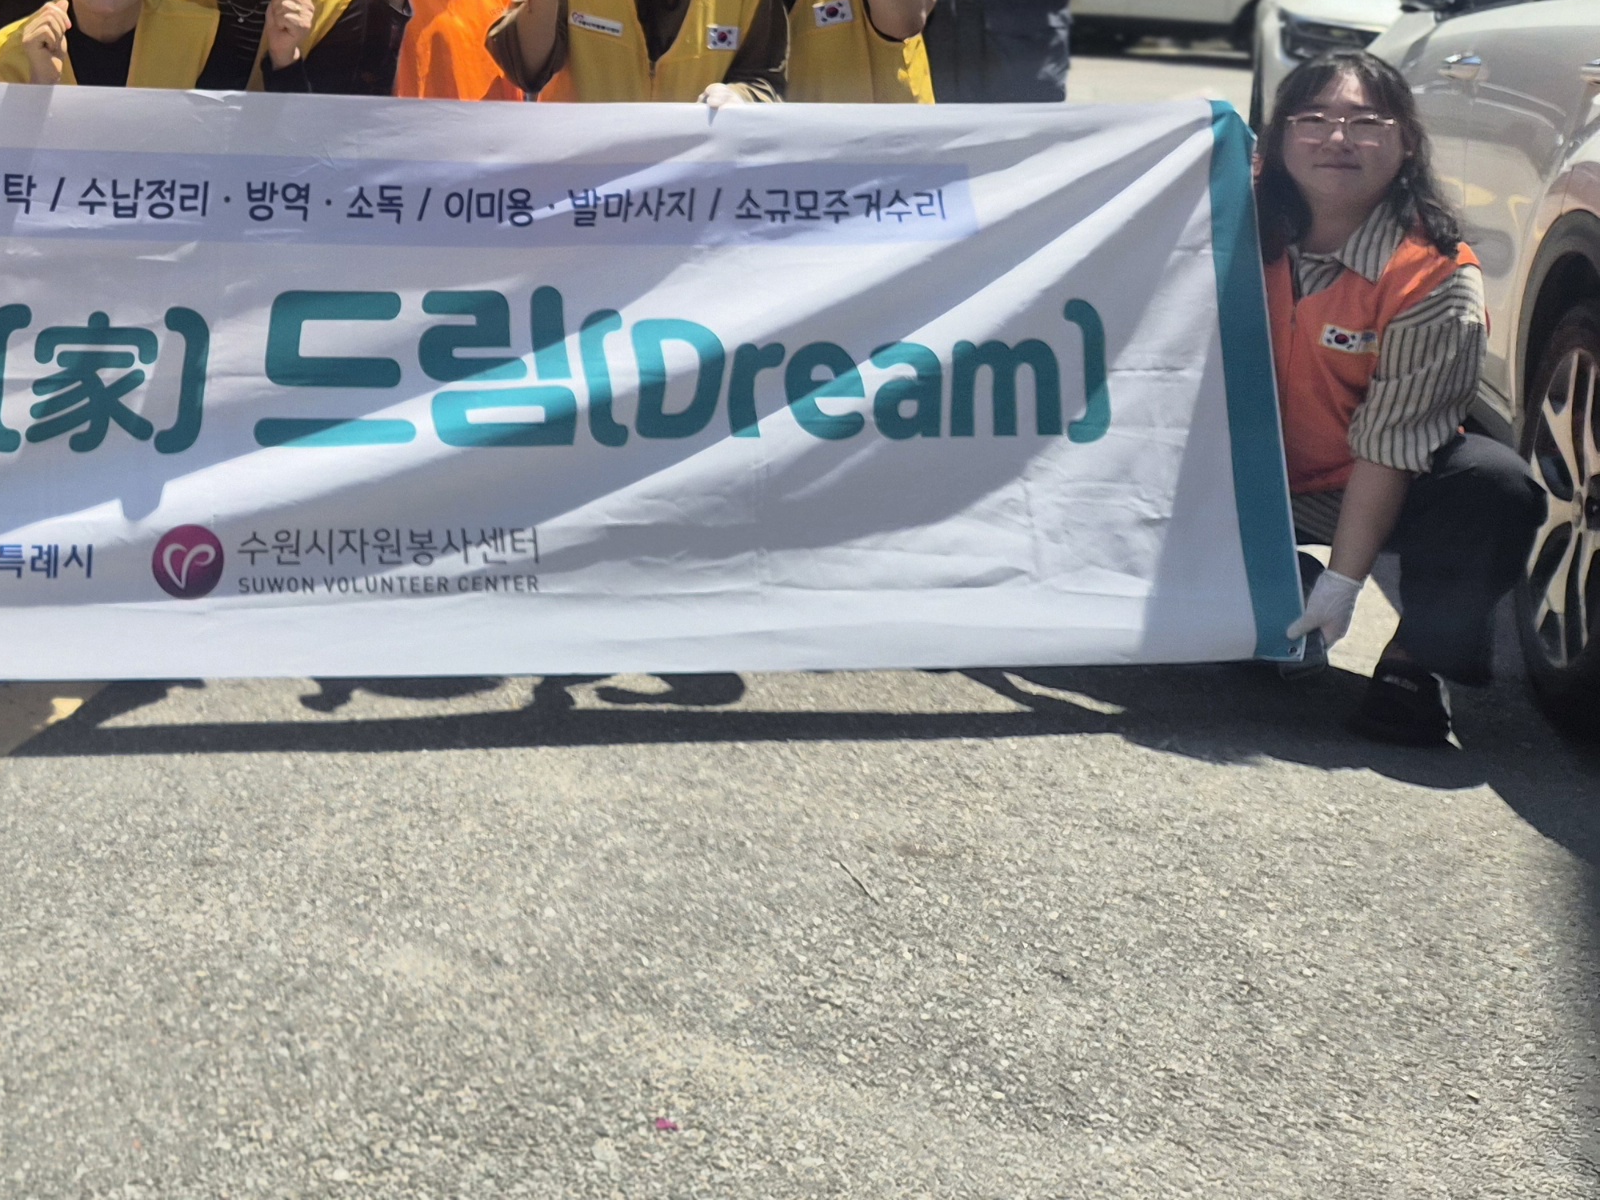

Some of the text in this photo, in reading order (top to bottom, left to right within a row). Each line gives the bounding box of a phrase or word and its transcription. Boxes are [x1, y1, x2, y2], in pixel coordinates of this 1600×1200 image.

[78, 178, 211, 219] 수납정리
[247, 181, 311, 221] 방역
[346, 185, 404, 224] 소독
[444, 188, 534, 228] 이미용
[567, 187, 696, 227] 발마사지
[735, 187, 947, 223] 소규모주거수리
[253, 285, 1112, 447] 드림(Dream)
[237, 527, 540, 566] 수원시자원봉사센터
[238, 574, 539, 593] SUWON VOLUNTEER CENTER
